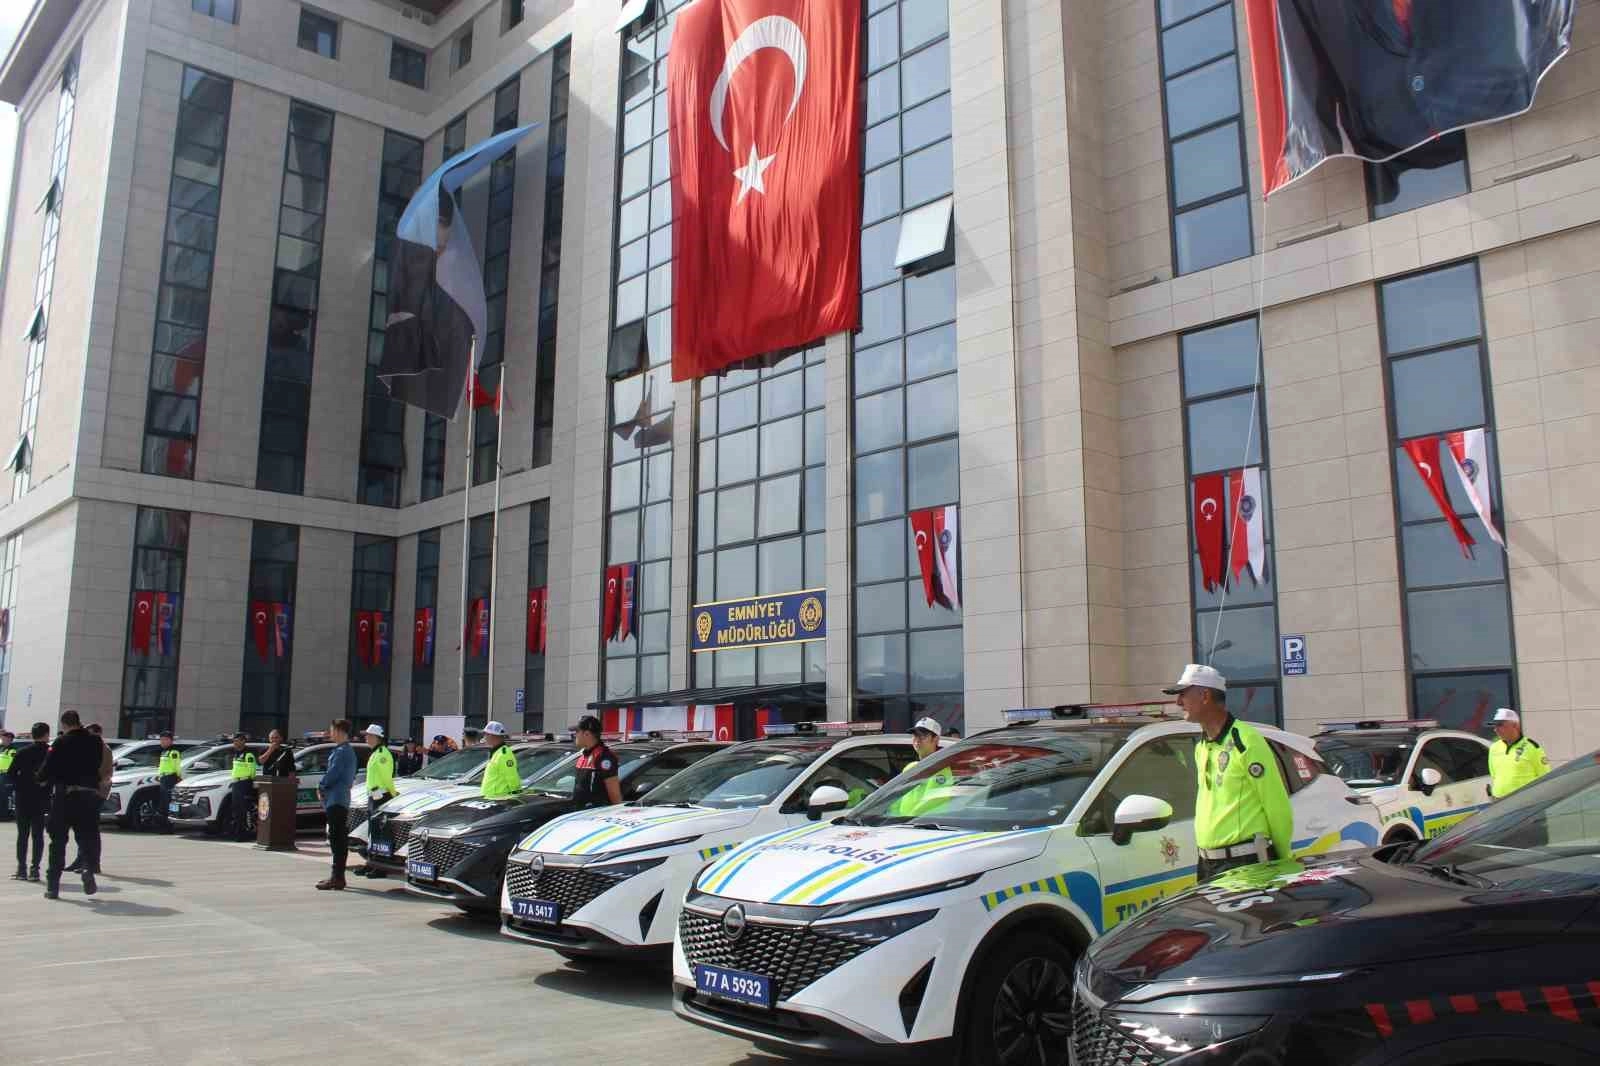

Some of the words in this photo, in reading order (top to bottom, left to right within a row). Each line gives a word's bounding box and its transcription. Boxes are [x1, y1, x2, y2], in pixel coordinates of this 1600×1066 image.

[728, 601, 784, 621] EMNİYET
[717, 619, 796, 643] MÜDÜRLÜĞÜ
[1285, 639, 1303, 660] P
[816, 844, 897, 864] POLİSİ
[518, 902, 527, 914] 77
[528, 904, 534, 915] A
[535, 905, 553, 918] 5417
[704, 971, 717, 987] 77
[720, 974, 730, 990] A
[732, 977, 762, 997] 5932
